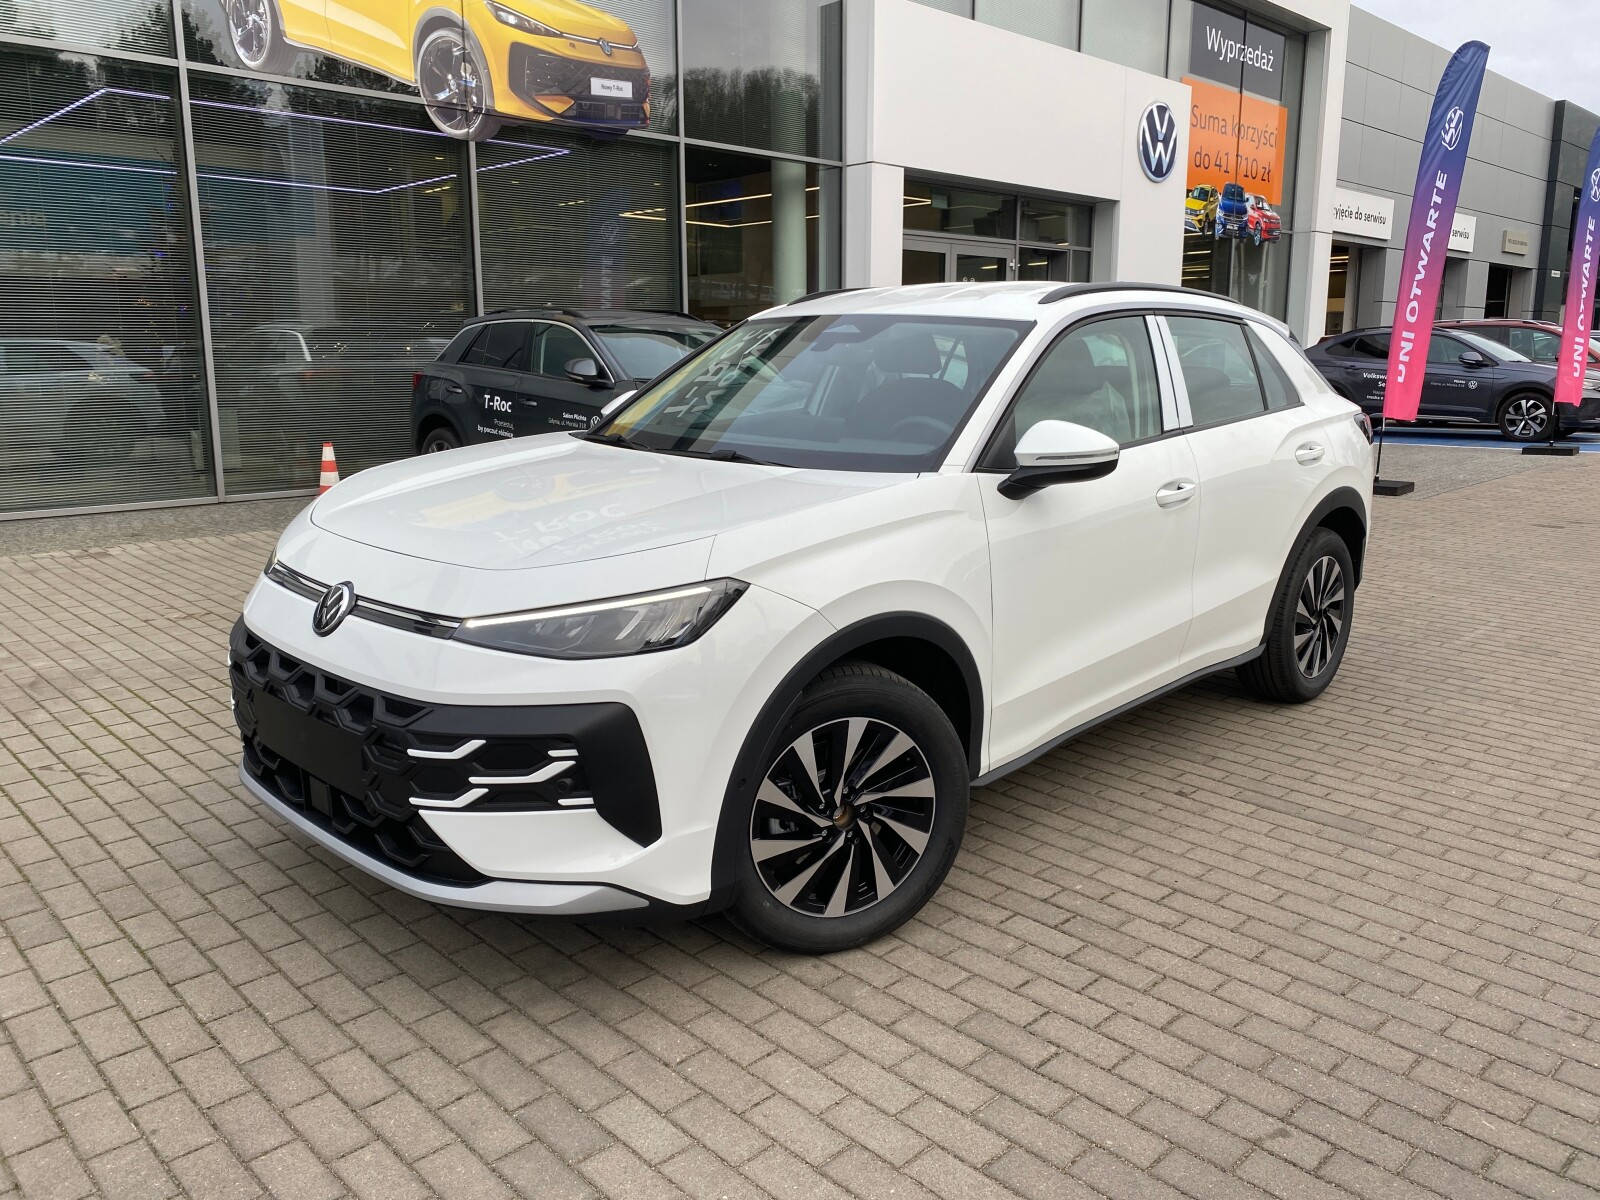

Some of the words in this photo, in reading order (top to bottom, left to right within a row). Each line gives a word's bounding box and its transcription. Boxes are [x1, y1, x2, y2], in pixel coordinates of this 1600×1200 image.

[1206, 25, 1274, 72] Wyprzedaż
[1191, 104, 1227, 136] Suma
[1231, 114, 1278, 150] korzyści
[1194, 145, 1211, 170] do
[1214, 149, 1230, 174] 41
[1236, 154, 1259, 180] 710
[1261, 162, 1272, 183] zł
[1354, 206, 1363, 221] do
[1364, 212, 1387, 225] serwisu
[1452, 228, 1470, 240] serwisu
[1405, 169, 1448, 325] OTWARTE
[484, 394, 512, 413] T-Roc
